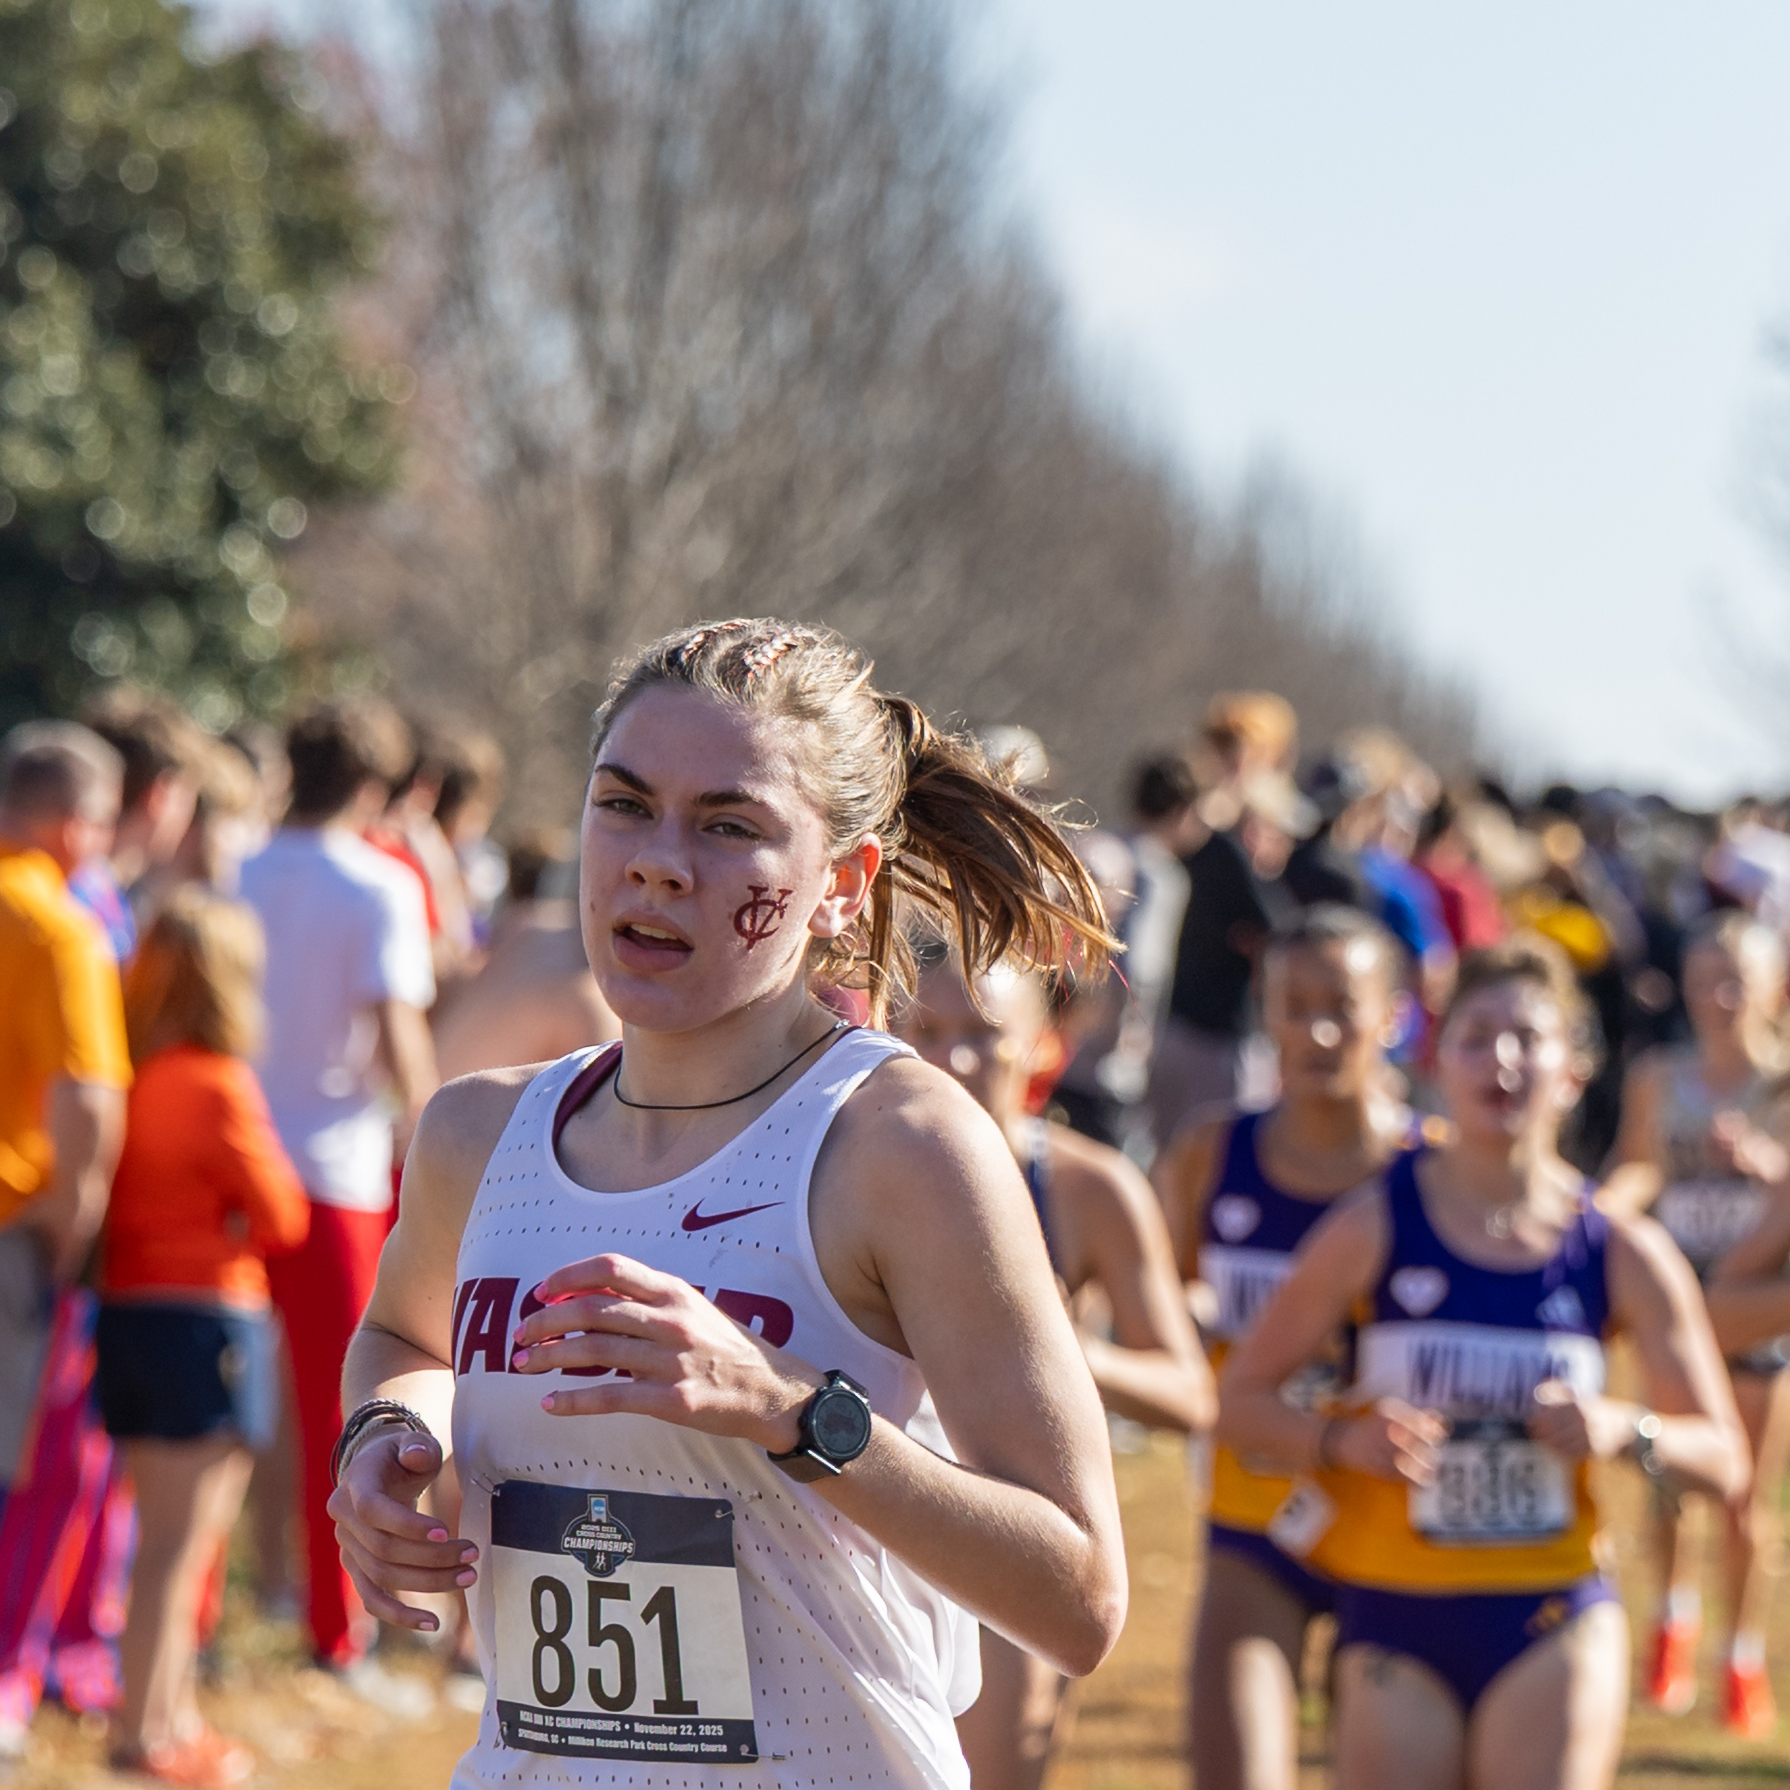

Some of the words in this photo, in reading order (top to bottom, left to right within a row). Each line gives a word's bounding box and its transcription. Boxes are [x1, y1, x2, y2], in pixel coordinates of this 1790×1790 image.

[563, 1536, 634, 1554] CHAMPIONSHIPS
[530, 1575, 699, 1716] 851
[555, 1716, 621, 1732] CHAMPIONSHIPS
[634, 1722, 678, 1735] November
[679, 1724, 697, 1736] 22,
[698, 1724, 724, 1736] 2025
[596, 1737, 629, 1749] Research
[630, 1739, 646, 1750] Park
[646, 1741, 668, 1751] Cross
[669, 1742, 699, 1753] Country
[700, 1742, 728, 1753] Course
